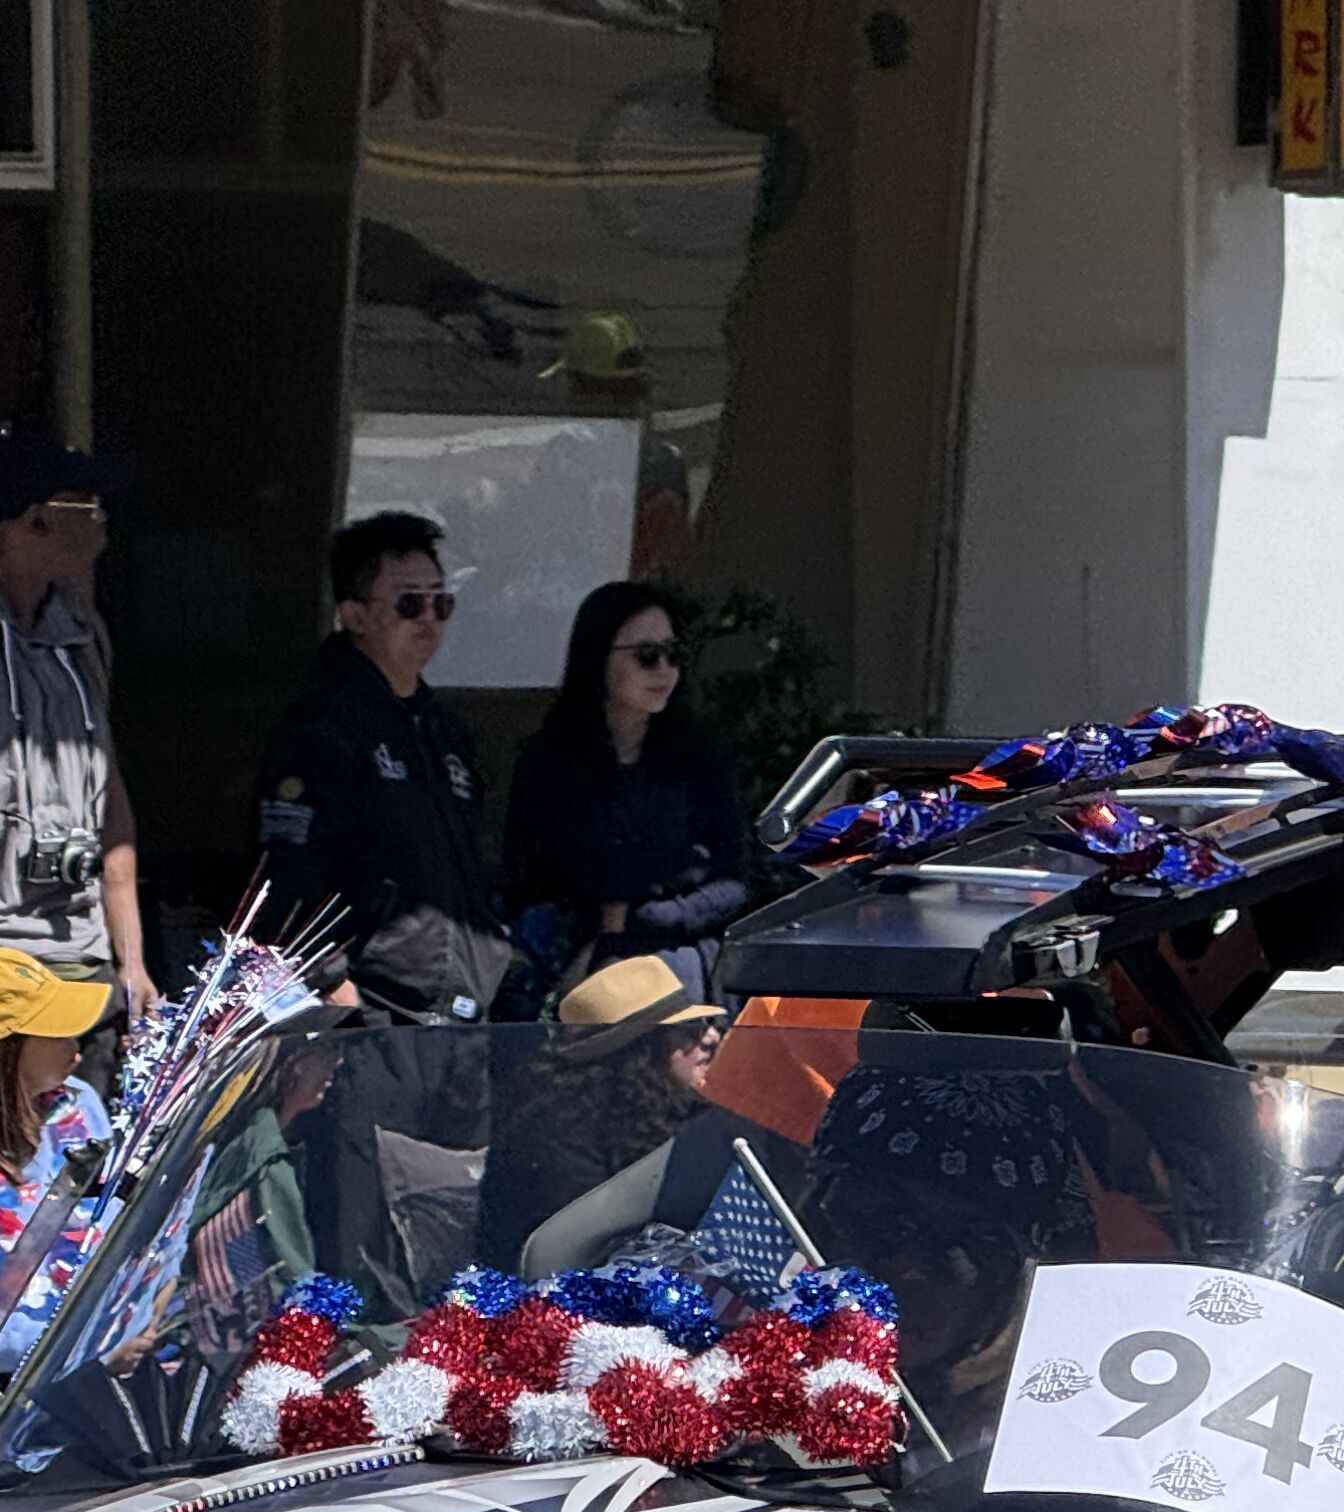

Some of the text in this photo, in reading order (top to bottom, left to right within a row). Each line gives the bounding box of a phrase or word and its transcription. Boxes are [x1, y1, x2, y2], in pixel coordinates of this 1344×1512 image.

[1201, 1298, 1245, 1314] JULY
[1031, 1379, 1073, 1395] JULY
[1098, 1330, 1314, 1485] 94
[1163, 1472, 1208, 1489] JULY
